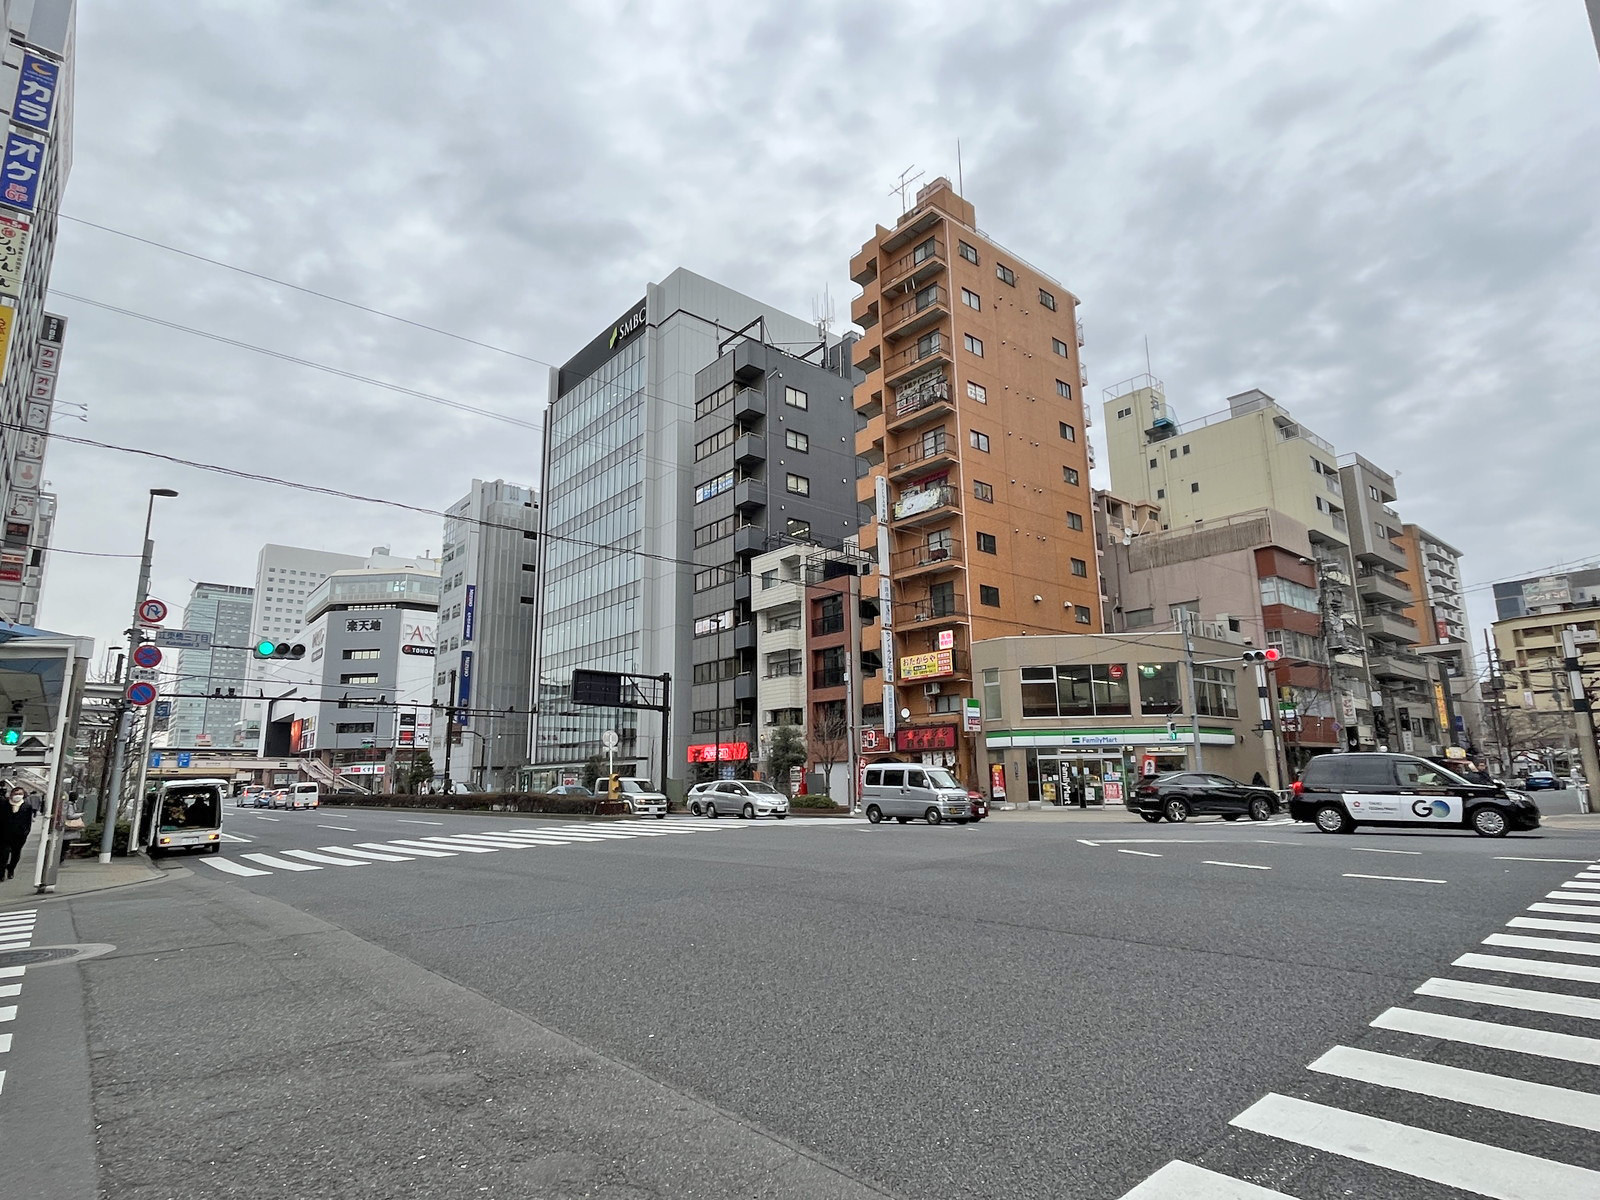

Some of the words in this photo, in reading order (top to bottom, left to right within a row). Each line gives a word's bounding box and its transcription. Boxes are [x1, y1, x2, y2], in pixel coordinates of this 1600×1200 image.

[619, 307, 646, 340] SMBC
[903, 654, 935, 667] おたからや
[1061, 762, 1072, 804] FamilyMart
